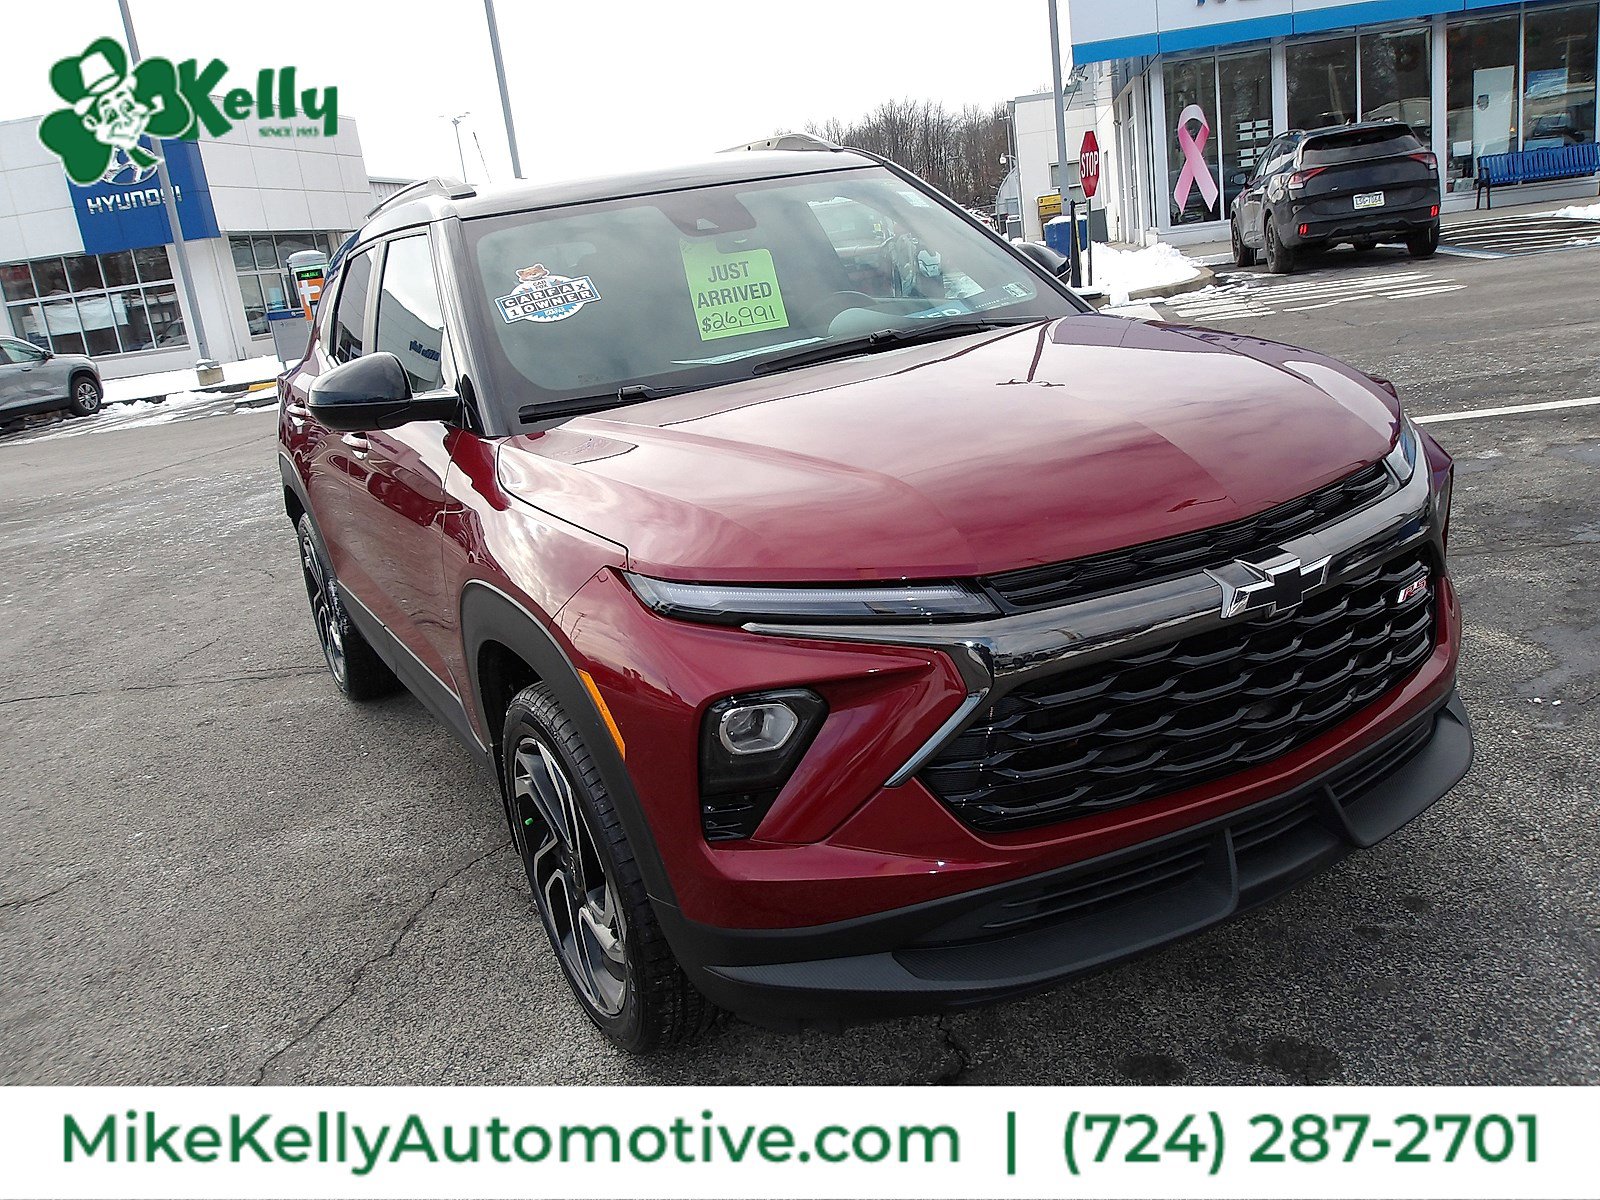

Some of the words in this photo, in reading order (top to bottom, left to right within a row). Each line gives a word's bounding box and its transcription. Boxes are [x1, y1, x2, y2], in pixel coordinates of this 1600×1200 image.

[1081, 151, 1099, 178] STOP
[708, 261, 749, 283] JUST
[503, 283, 587, 308] CARFAX
[523, 290, 593, 314] OWNER
[698, 281, 772, 309] ARRIVED
[702, 304, 777, 333] $26,991
